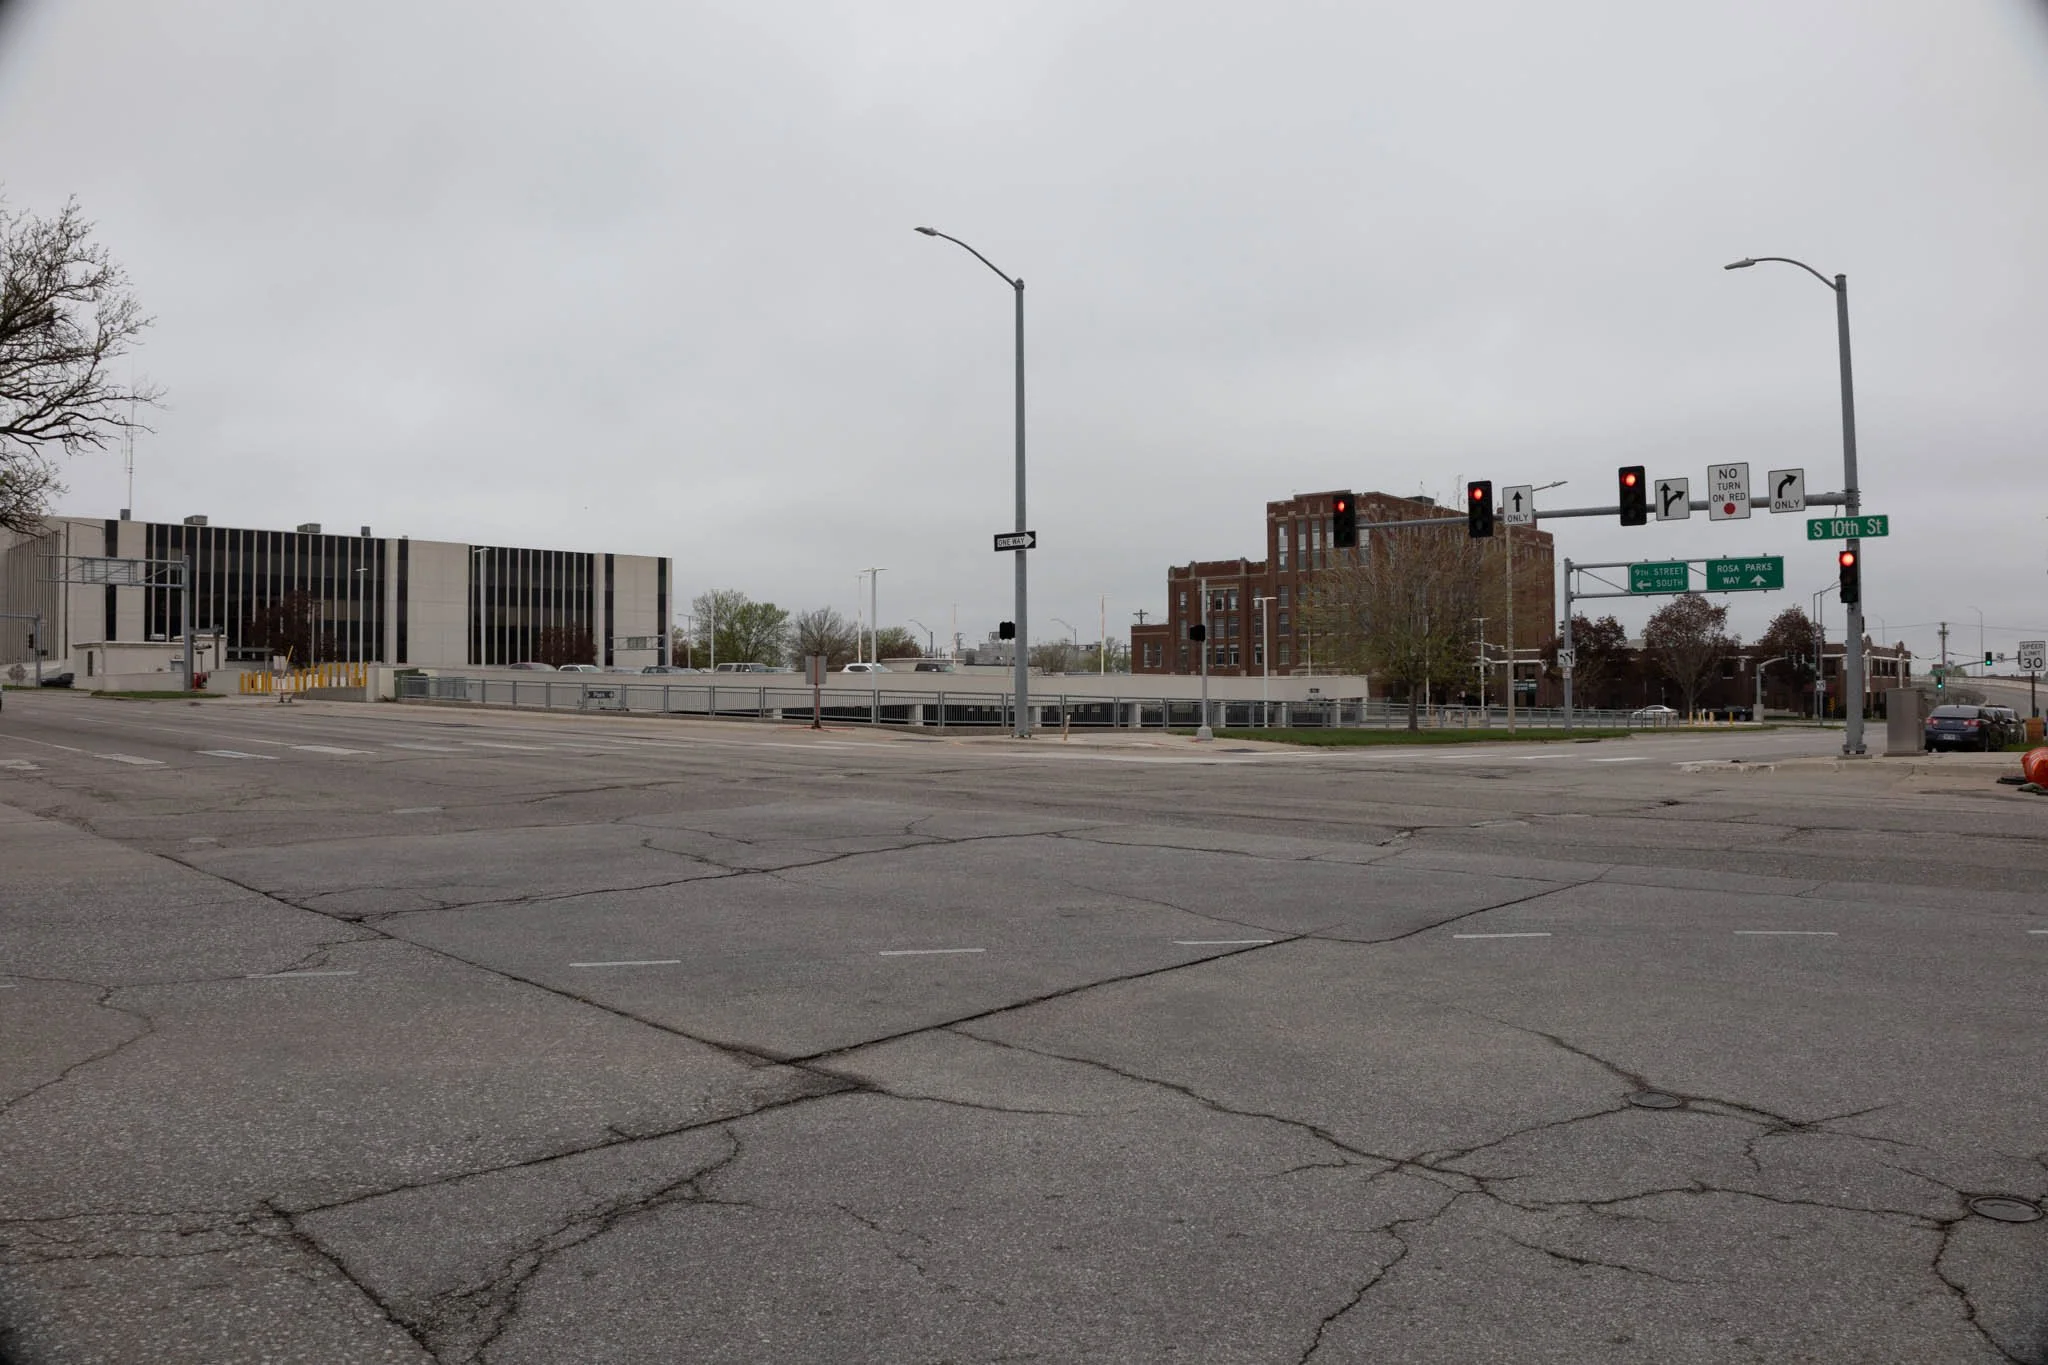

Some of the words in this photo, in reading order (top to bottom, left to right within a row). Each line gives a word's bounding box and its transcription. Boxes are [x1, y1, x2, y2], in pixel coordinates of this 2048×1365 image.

[1719, 468, 1737, 479] NO
[1717, 481, 1740, 491] TURN
[1712, 494, 1724, 503] ON
[1729, 492, 1745, 501] RED
[1774, 500, 1800, 510] ONLY
[1507, 513, 1528, 522] ONLY
[1813, 521, 1823, 537] S
[1830, 520, 1859, 536] 10th
[1867, 518, 1882, 535] St
[998, 538, 1011, 546] ONE
[1012, 537, 1024, 545] WAY
[1654, 567, 1684, 576] STREET
[1717, 564, 1739, 573] ROSA
[1745, 563, 1773, 572] PARKS
[1656, 579, 1683, 587] SOUTH
[1723, 576, 1741, 585] WAY
[2023, 657, 2043, 669] 30
